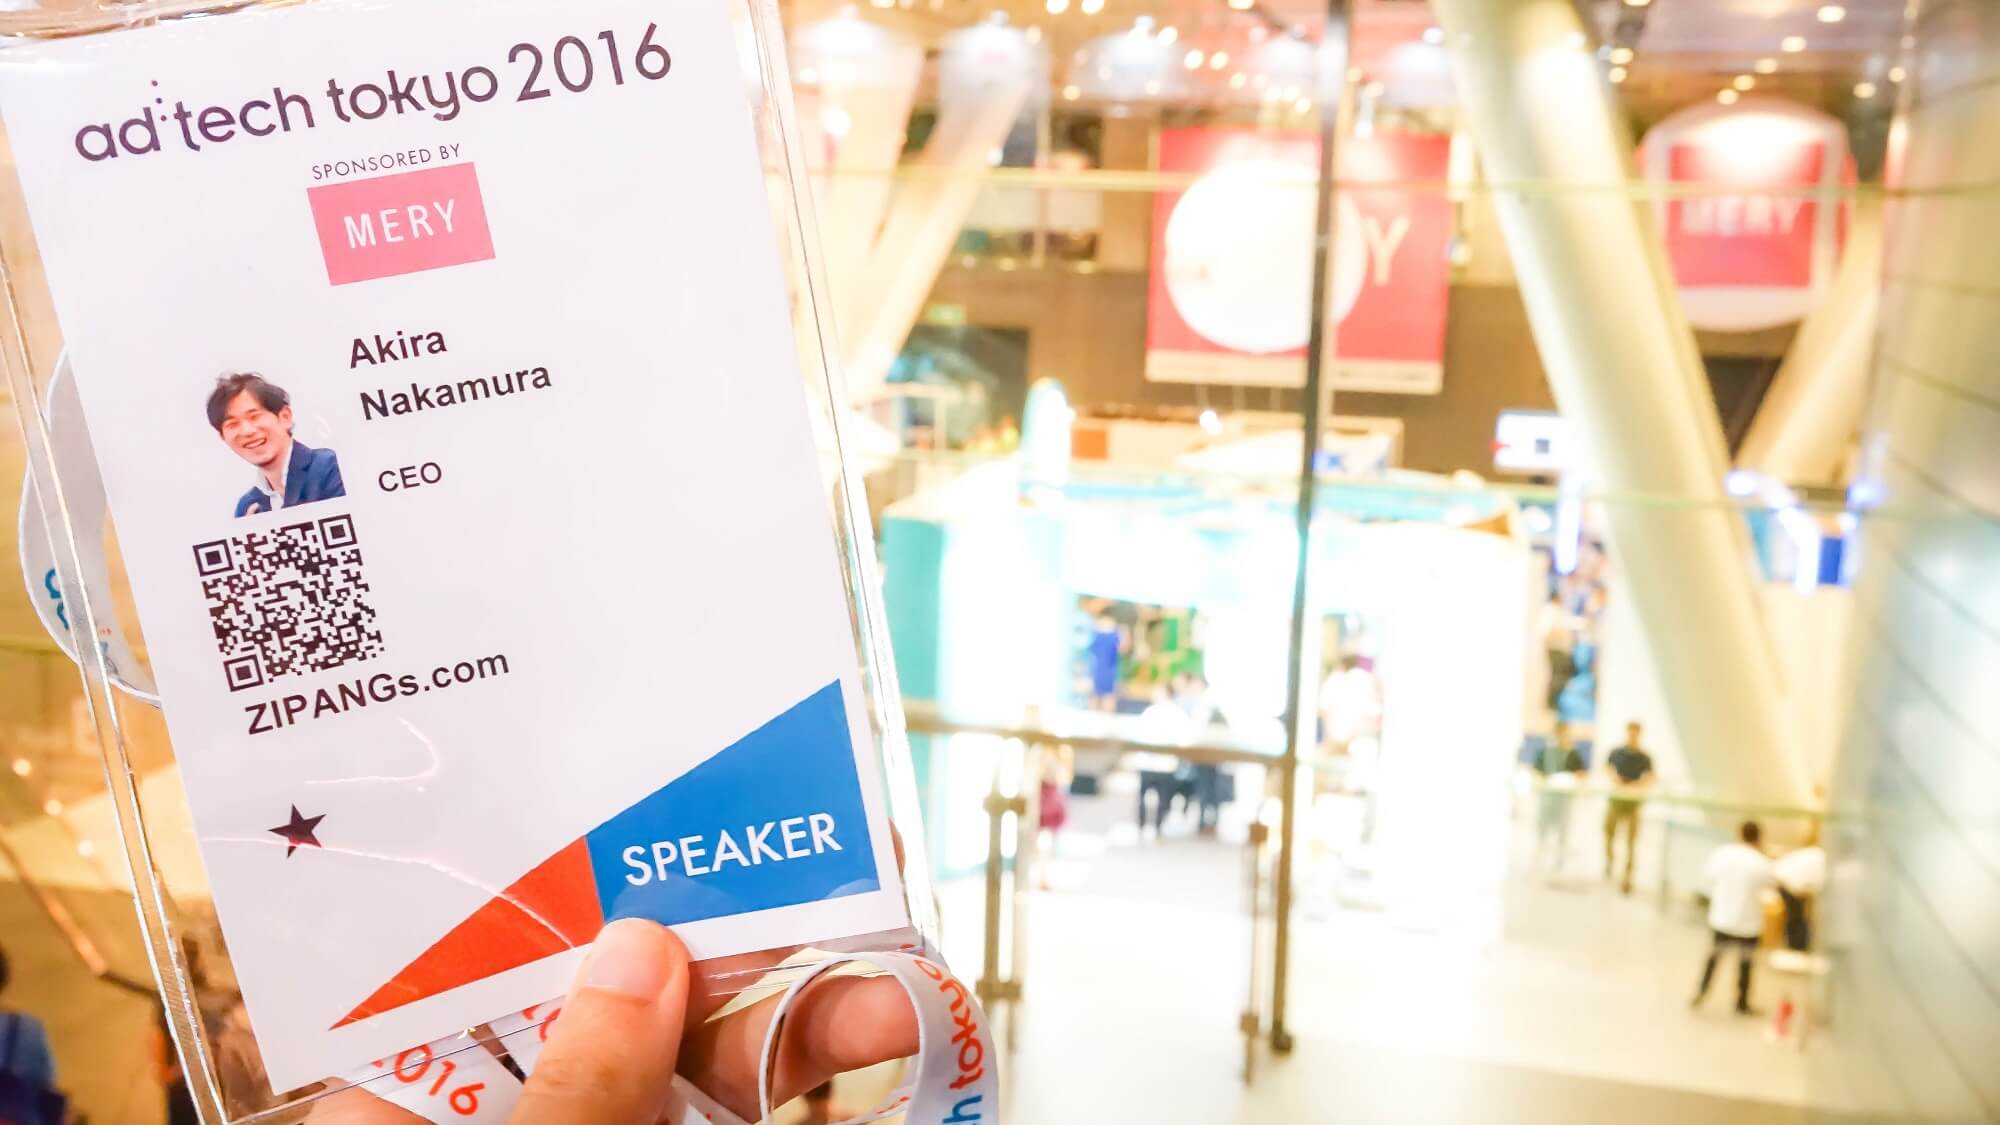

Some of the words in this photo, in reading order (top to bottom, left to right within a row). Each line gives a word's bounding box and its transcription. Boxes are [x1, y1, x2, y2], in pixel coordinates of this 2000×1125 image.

[326, 71, 499, 123] tokyo
[508, 22, 672, 102] 2016
[311, 148, 432, 181] SPONSORED
[439, 143, 460, 160] BY
[343, 199, 455, 249] MERY
[350, 330, 448, 369] Akira
[359, 366, 553, 421] Nakamura
[378, 461, 442, 493] CEO
[244, 653, 509, 735] ZIPANGs.com
[622, 812, 843, 886] SPEAKER
[368, 1043, 486, 1116] 016
